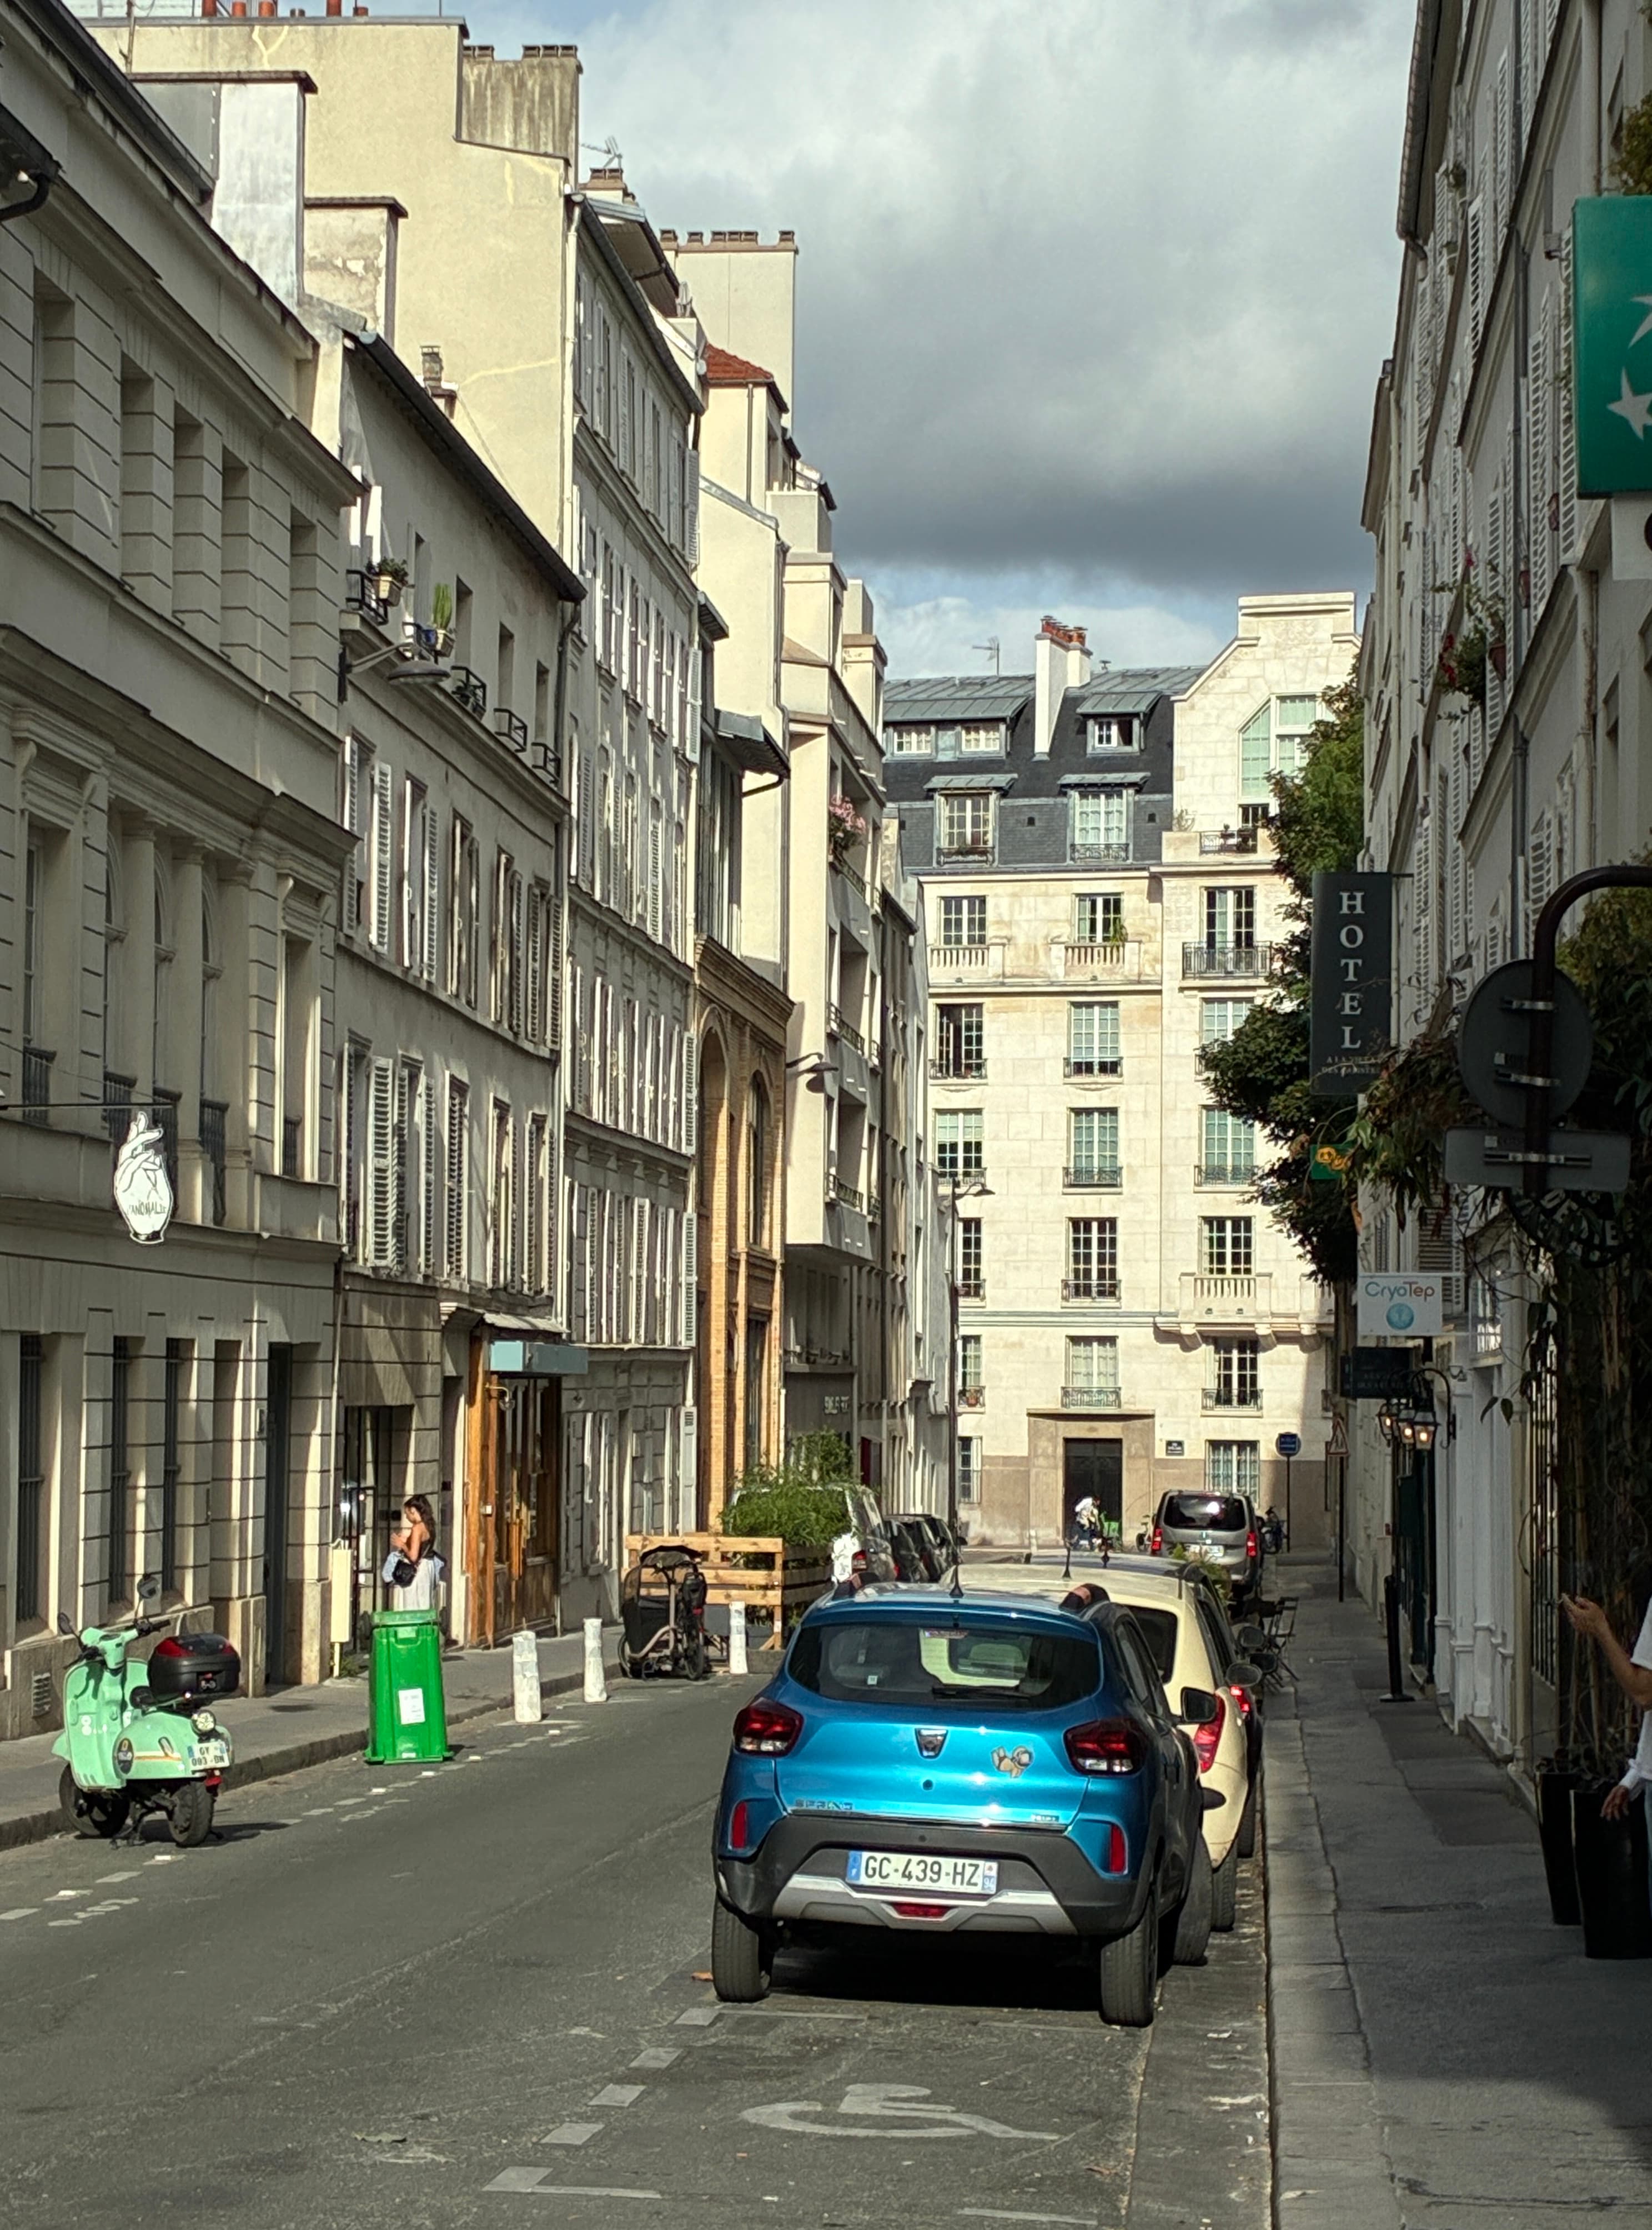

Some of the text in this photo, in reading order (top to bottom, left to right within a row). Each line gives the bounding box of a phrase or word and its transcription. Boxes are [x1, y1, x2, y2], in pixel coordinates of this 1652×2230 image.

[1339, 891, 1365, 1049] HOTEL
[1365, 1281, 1435, 1302] CryoTep
[865, 1855, 980, 1887] GC-439-HZ
